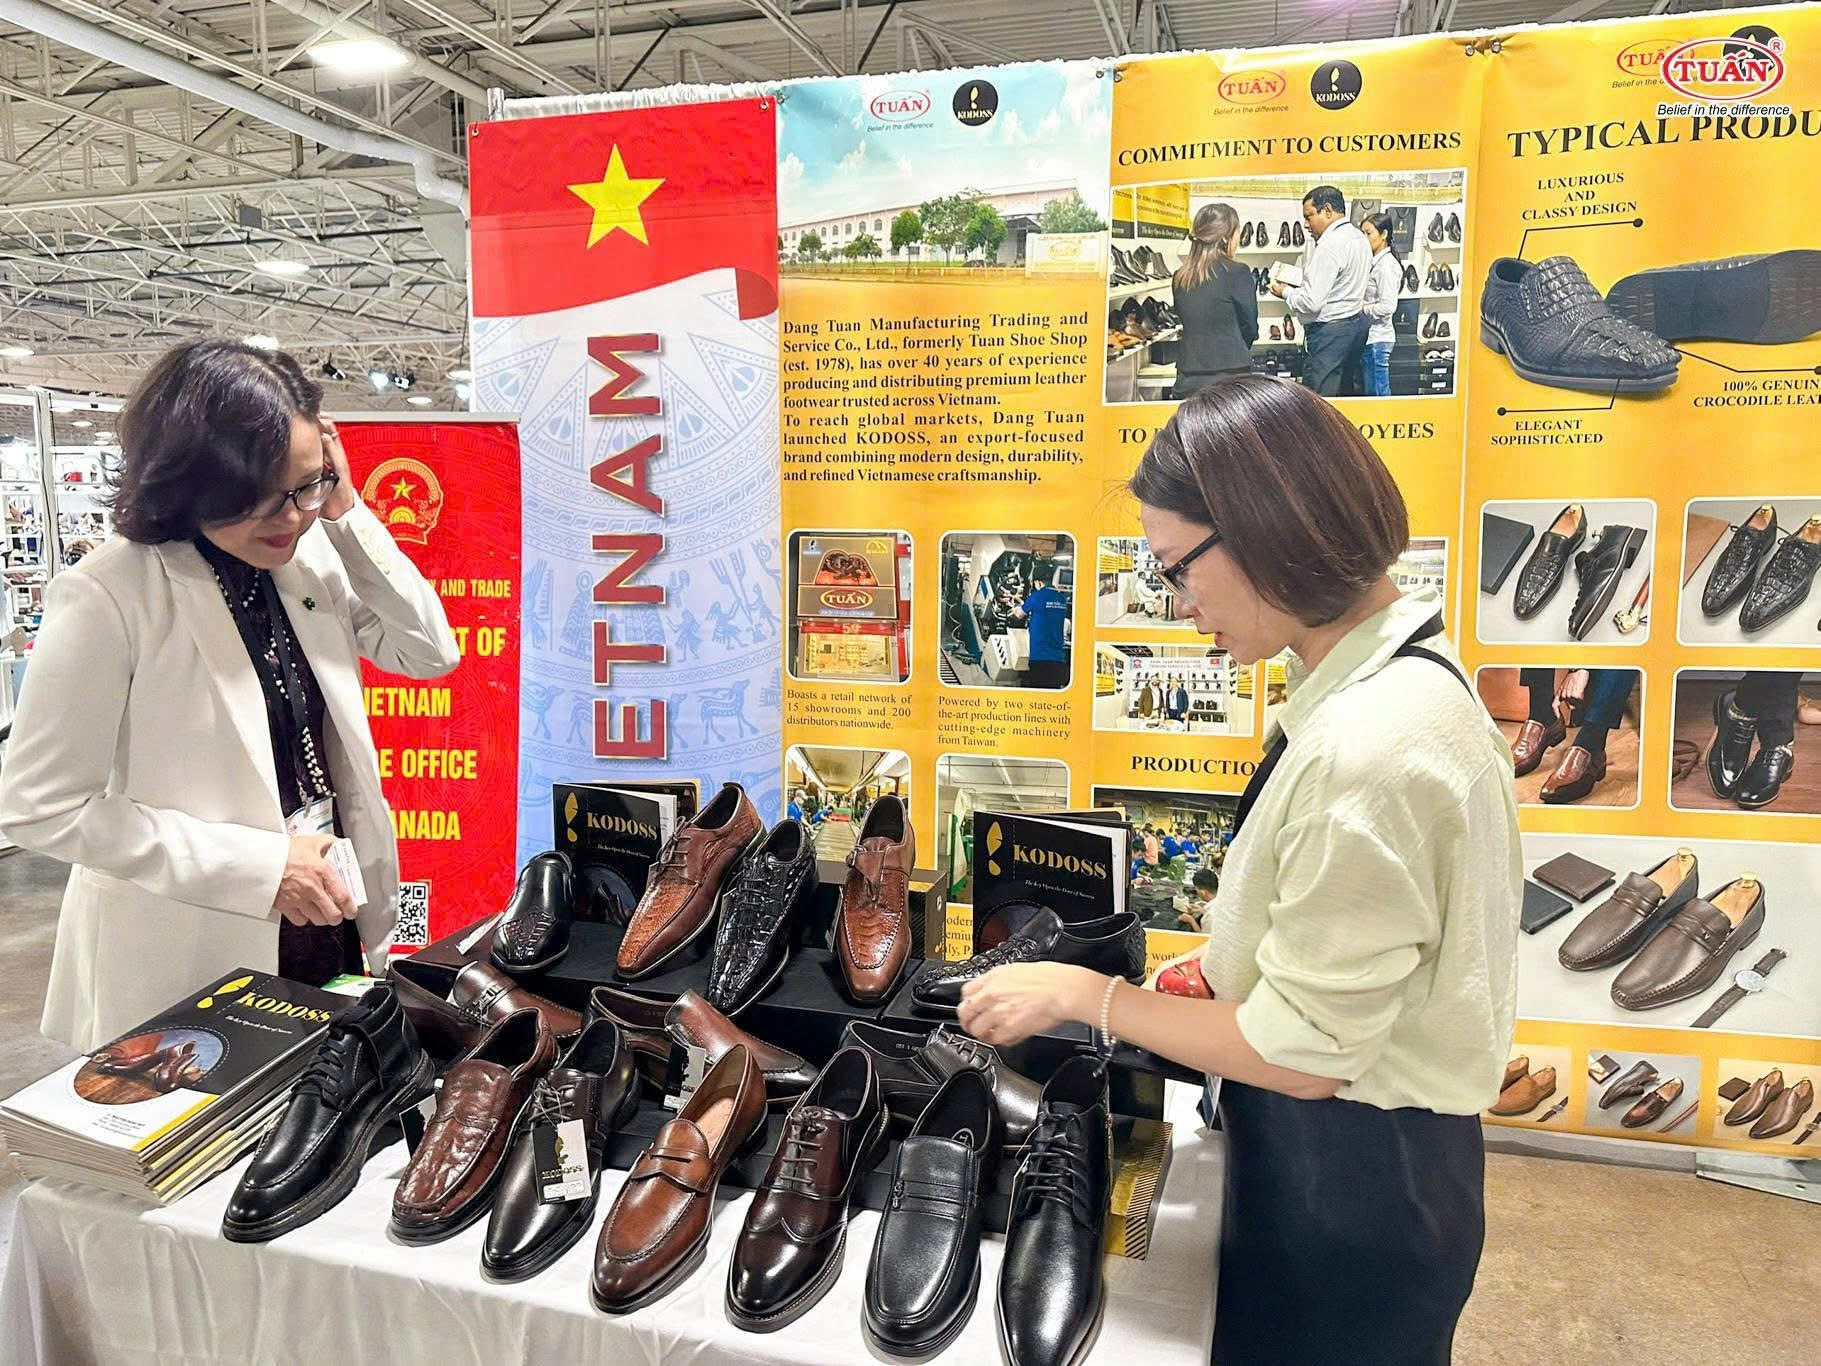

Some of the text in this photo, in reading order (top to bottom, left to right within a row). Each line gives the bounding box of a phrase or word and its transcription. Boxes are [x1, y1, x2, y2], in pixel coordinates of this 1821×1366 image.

[1315, 92, 1356, 102] KODOSS
[957, 109, 994, 120] KODOSS
[1507, 118, 1680, 158] TYPICAL
[1118, 131, 1462, 167] COMMITMENT TO CUSTOMERS
[1538, 172, 1625, 190] LUXURIOUS
[1564, 189, 1596, 203] AND
[1522, 201, 1638, 221] CLASSY DESIGN
[783, 311, 1088, 336] Dang Tuan Manufacturing Trading and
[783, 331, 1088, 353] Service Co., Ltd., formerly Tuan Shoe Shop
[783, 353, 1087, 374] (est. 1978), has over 40 years of experience
[783, 371, 1087, 393] producing and distributing premium leather
[1723, 379, 1821, 392] 100% GENUIN
[783, 392, 1001, 409] footwear trusted across Vietnam.
[1693, 393, 1782, 408] CROCODILE
[784, 410, 1085, 428] To reach global markets, Dang Tuan
[1515, 419, 1583, 432] ELEGANT
[783, 429, 1084, 446] launched KODOSS, an export-focused
[1118, 428, 1147, 444] TO
[1358, 422, 1435, 440] OYEES
[1491, 432, 1604, 446] SOPHISTICATED
[783, 448, 1084, 466] brand combining modern design, durability,
[783, 467, 1041, 484] and refined Vietnamese craftsmanship.
[587, 332, 668, 760] ETNAM
[440, 579, 466, 598] AND
[471, 579, 512, 598] TRADE
[476, 626, 507, 657] OF
[787, 689, 913, 704] Boasts a retail network of
[939, 696, 1071, 711] Powered by two state-of-
[787, 703, 911, 717] 15 showrooms and 200
[938, 709, 1071, 725] the-art production lines with
[787, 715, 894, 730] distributors nationwide.
[938, 722, 1071, 740] cutting-edge machinery
[938, 734, 998, 747] from Taiwan.
[401, 749, 478, 780] OFFICE
[1131, 756, 1263, 777] PRODUCTIO
[586, 812, 658, 841] KODOSS
[1012, 844, 1107, 880] KODOSS
[946, 915, 973, 927] oder
[236, 991, 335, 1023] KODOSS
